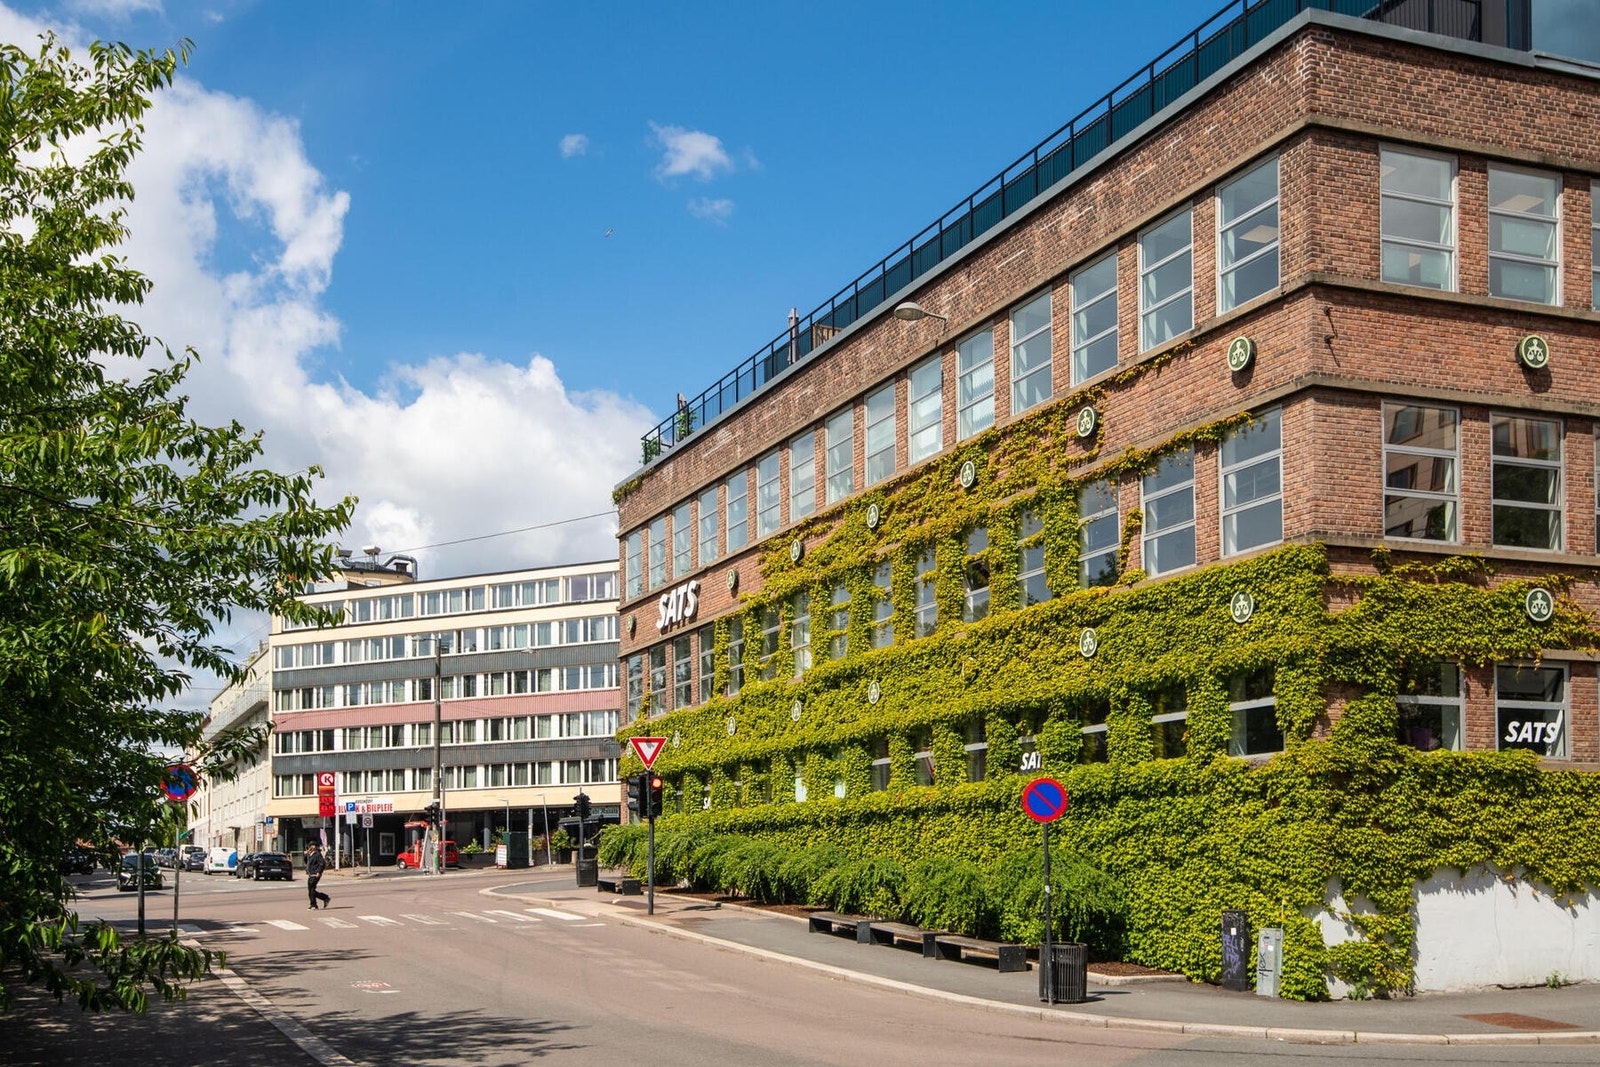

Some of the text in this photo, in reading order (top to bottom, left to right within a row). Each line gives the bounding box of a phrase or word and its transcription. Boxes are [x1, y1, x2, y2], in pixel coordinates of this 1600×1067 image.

[656, 580, 698, 629] SATS
[1504, 721, 1558, 744] SATS
[323, 775, 333, 785] K
[348, 803, 354, 811] P
